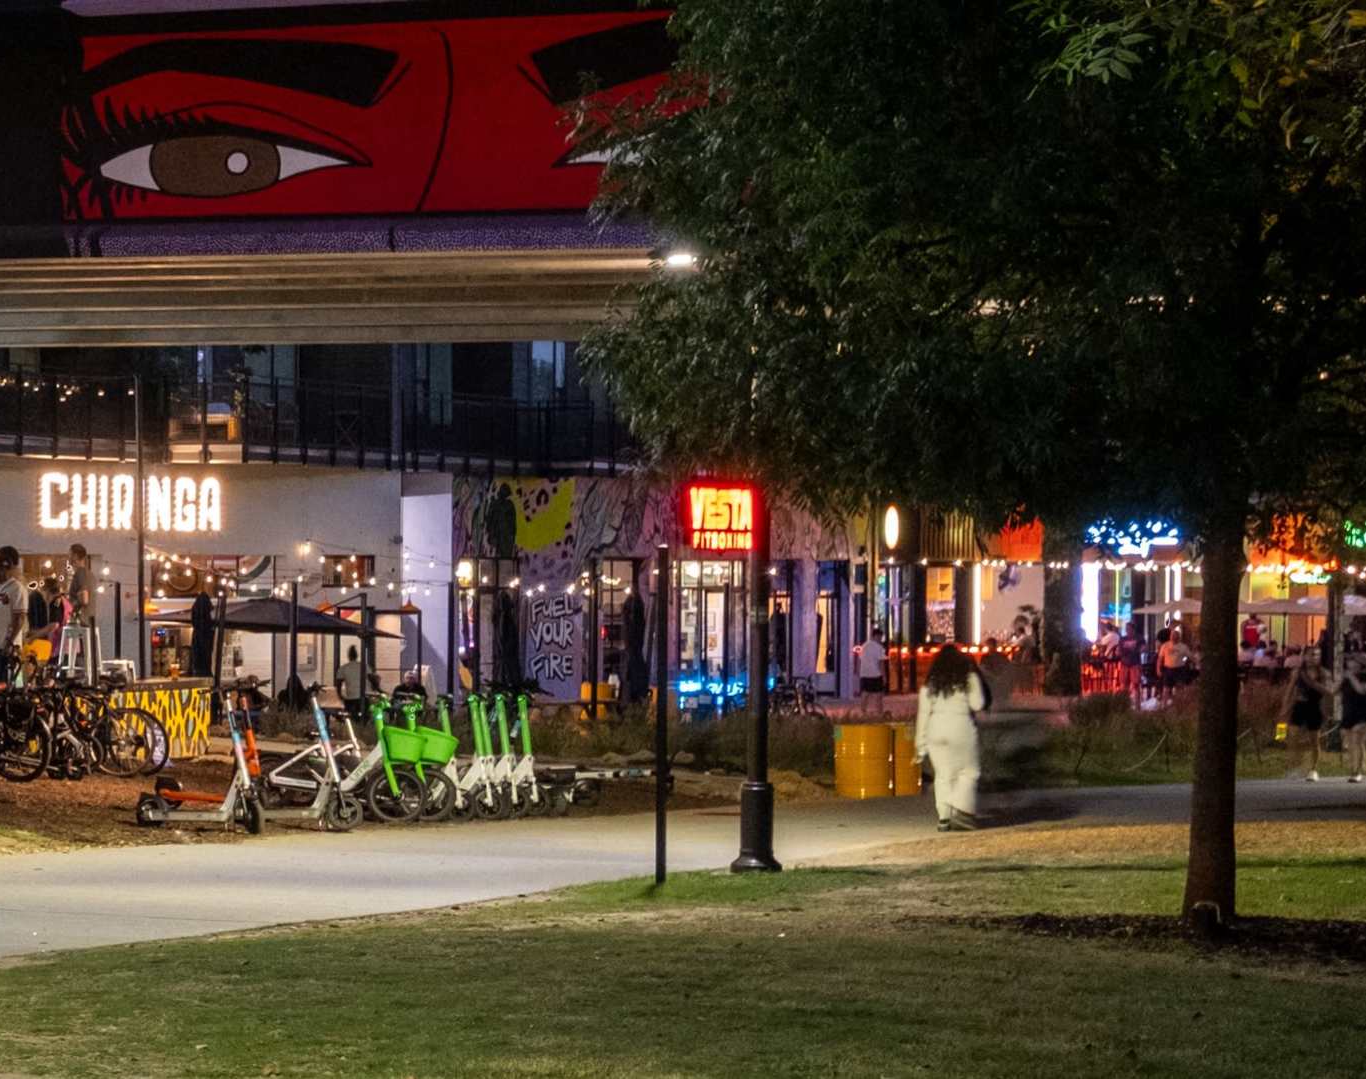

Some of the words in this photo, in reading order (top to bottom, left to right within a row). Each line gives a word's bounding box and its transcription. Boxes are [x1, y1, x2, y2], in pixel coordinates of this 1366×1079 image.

[38, 471, 222, 532] CHIRNGA
[689, 487, 753, 530] VESTA
[692, 531, 753, 550] FITBOXING
[531, 593, 575, 623] FUEL
[530, 618, 574, 651] YOUR
[531, 653, 575, 681] FIRE
